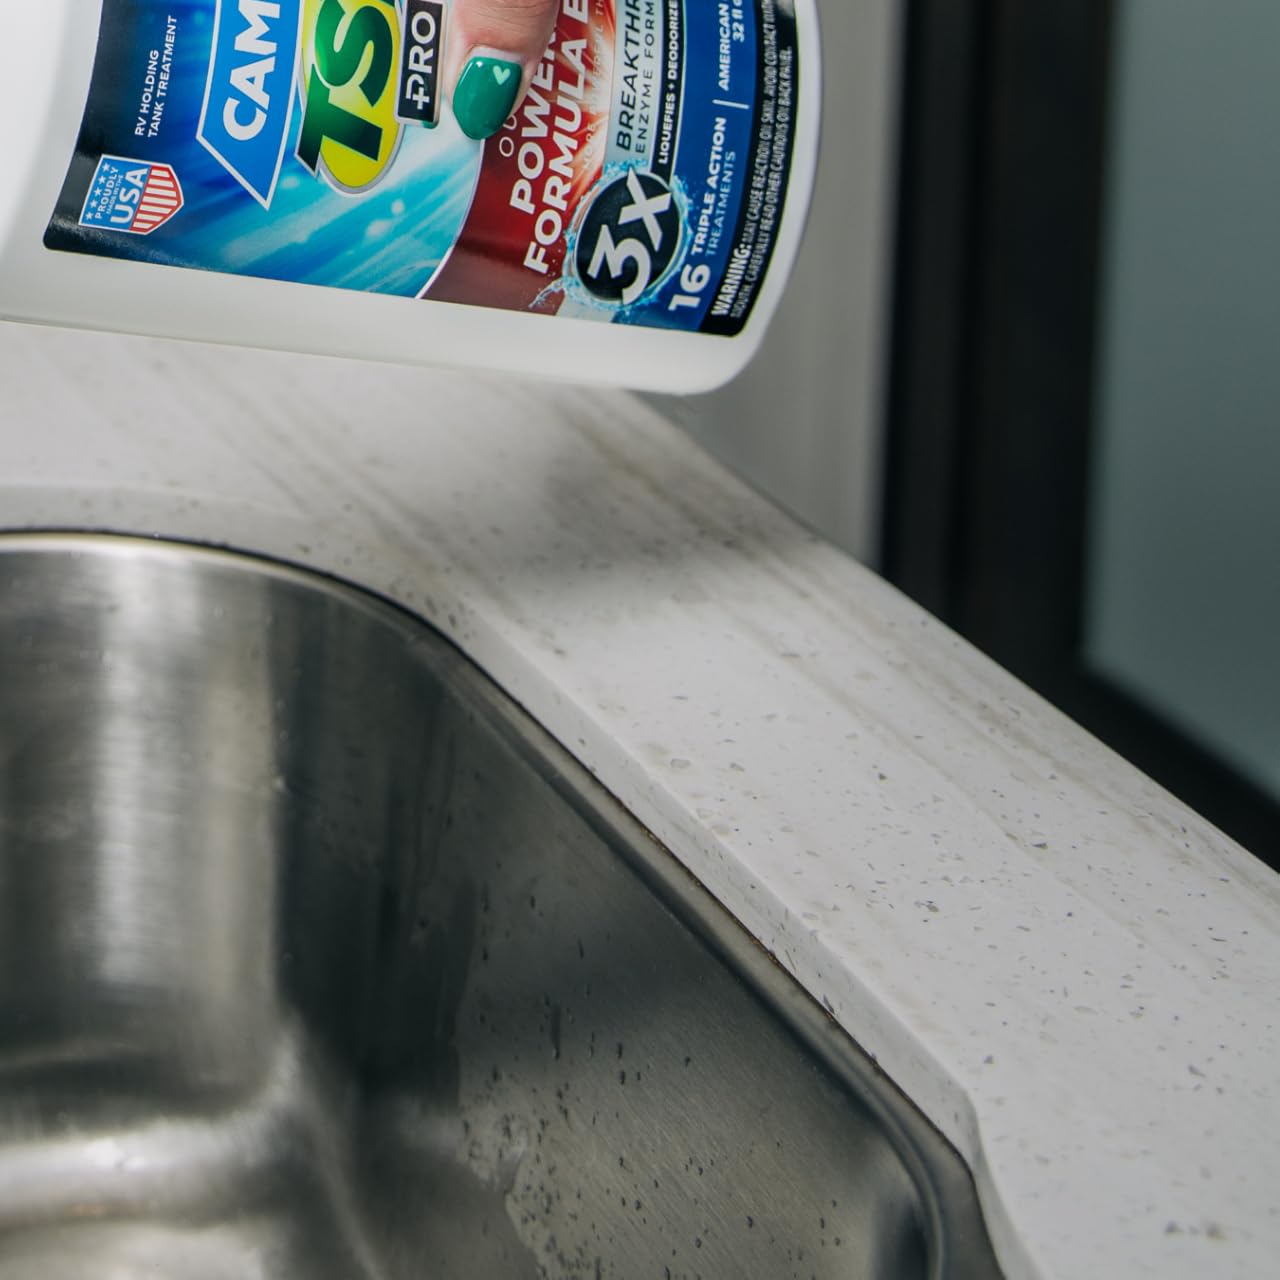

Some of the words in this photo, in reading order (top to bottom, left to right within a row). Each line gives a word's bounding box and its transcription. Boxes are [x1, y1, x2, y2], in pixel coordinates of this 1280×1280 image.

[717, 4, 731, 92] AMERICAN
[732, 21, 745, 43] 32
[763, 24, 778, 66] CONTACT
[140, 49, 159, 114] HOLDING
[147, 101, 165, 138] TANK
[156, 15, 177, 98] TREATMENT
[763, 66, 777, 97] AVOID
[778, 82, 792, 106] BACK
[134, 116, 147, 136] RV
[635, 69, 654, 154] ENZYME
[658, 92, 676, 164] LIQUEFIES
[523, 38, 588, 275] FORMULA
[752, 140, 770, 188] REACTION
[770, 123, 789, 170] CAUTIONS
[94, 166, 119, 219] PROUDLY
[110, 168, 148, 224] USA
[691, 191, 716, 256] TRIPLE
[706, 116, 727, 190] ACTION
[705, 151, 736, 257] TREATMENTS
[746, 189, 764, 220] CAUSE
[765, 169, 782, 203] OTHER
[586, 167, 672, 306] 3X
[760, 204, 777, 231] READ
[668, 263, 712, 312] 16
[710, 243, 753, 316] WARNING:
